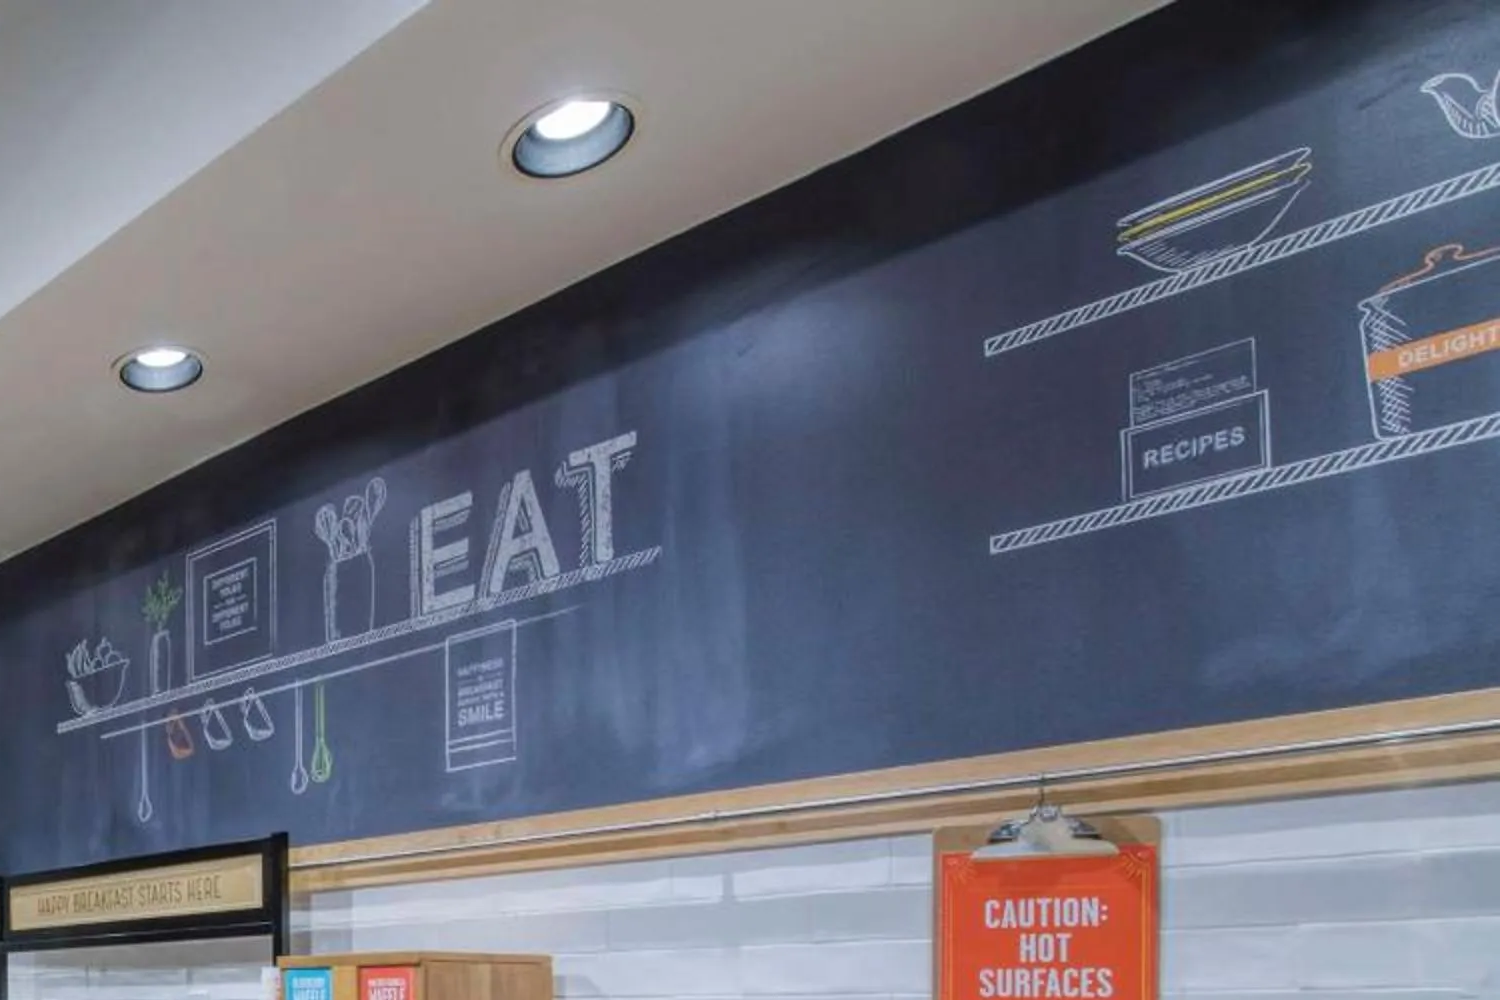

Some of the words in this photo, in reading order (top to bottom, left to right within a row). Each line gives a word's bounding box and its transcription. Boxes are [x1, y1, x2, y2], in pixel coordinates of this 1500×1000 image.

[1143, 426, 1245, 469] RECIPES
[411, 430, 637, 617] EAT
[457, 700, 505, 727] SMILE
[37, 892, 72, 915] HAPPY
[73, 885, 135, 913] BREAKFAST
[137, 880, 182, 908] STARTS
[187, 874, 222, 901] HERE
[984, 897, 1108, 929] CAUTION:
[1019, 933, 1072, 963] HOT
[979, 968, 1113, 998] SURFACES
